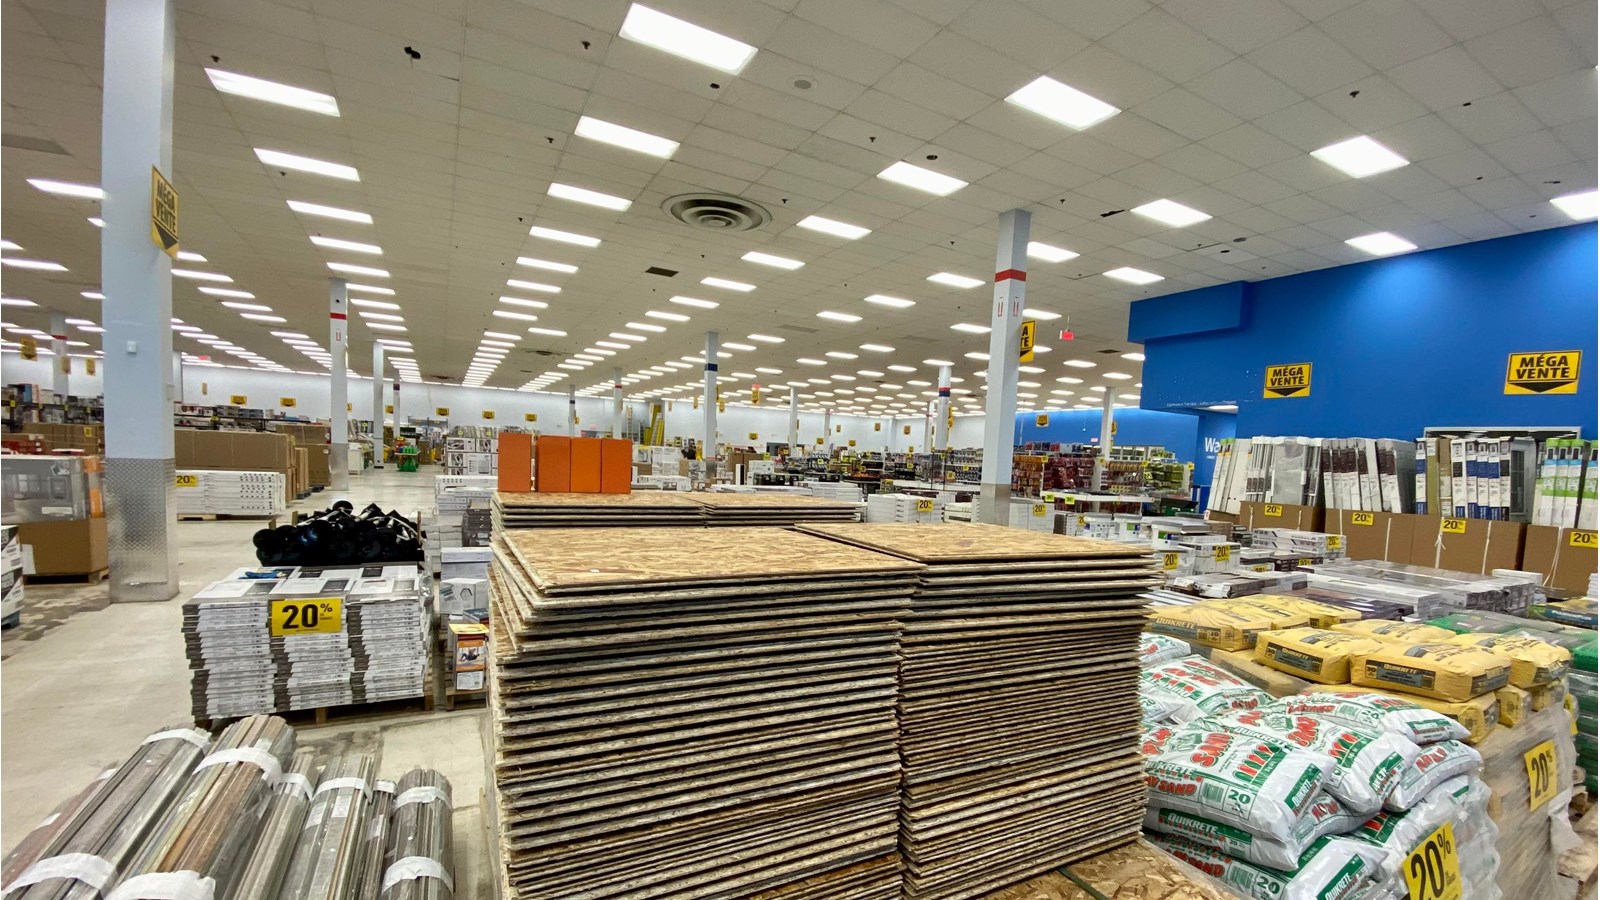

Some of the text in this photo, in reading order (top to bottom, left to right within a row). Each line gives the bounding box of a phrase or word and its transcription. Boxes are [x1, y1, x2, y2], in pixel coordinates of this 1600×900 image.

[156, 197, 176, 233] VENTE
[1519, 354, 1569, 368] MÉGA
[1272, 366, 1304, 377] MÉGA
[1516, 367, 1570, 379] VENTE
[1270, 376, 1305, 386] VENTE
[281, 603, 333, 629] 20%
[1156, 617, 1196, 630] QUIKRETE
[1158, 780, 1198, 796] SAND
[1228, 788, 1251, 805] 20
[1168, 813, 1219, 835] QUIKRETE
[1257, 876, 1281, 895] 20
[1324, 872, 1352, 900] QUIKRETE
